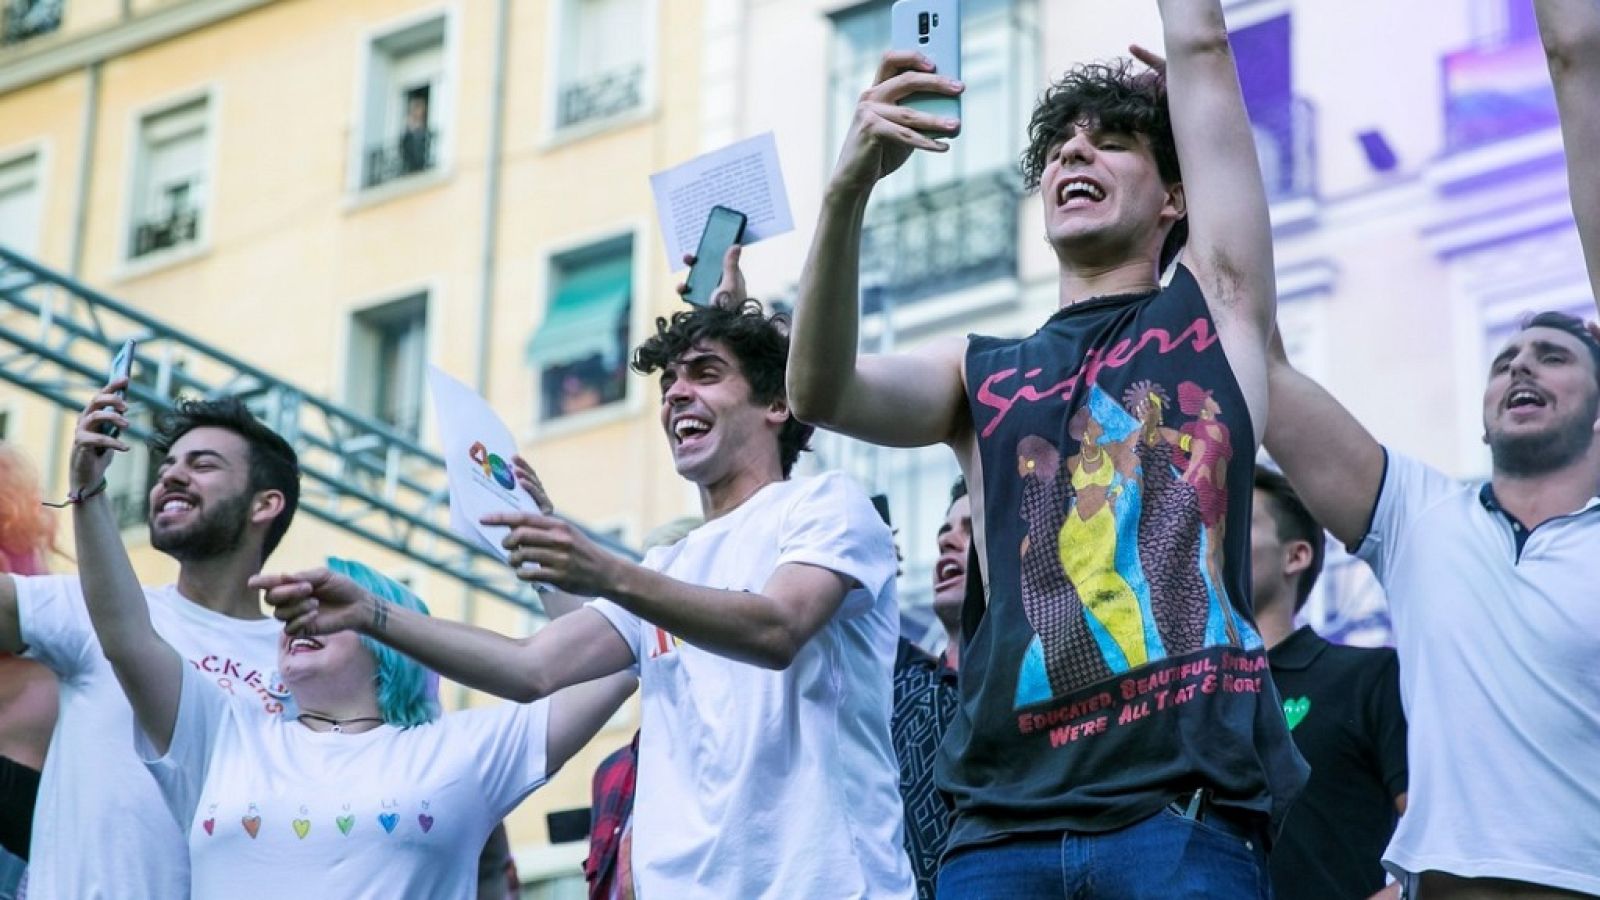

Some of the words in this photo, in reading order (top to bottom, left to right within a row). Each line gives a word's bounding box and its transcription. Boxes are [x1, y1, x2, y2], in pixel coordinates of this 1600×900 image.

[1120, 657, 1217, 700] BEAUTIFUL,
[1050, 716, 1108, 748] WE'RE
[1118, 701, 1150, 726] ALL
[1201, 674, 1217, 694] &
